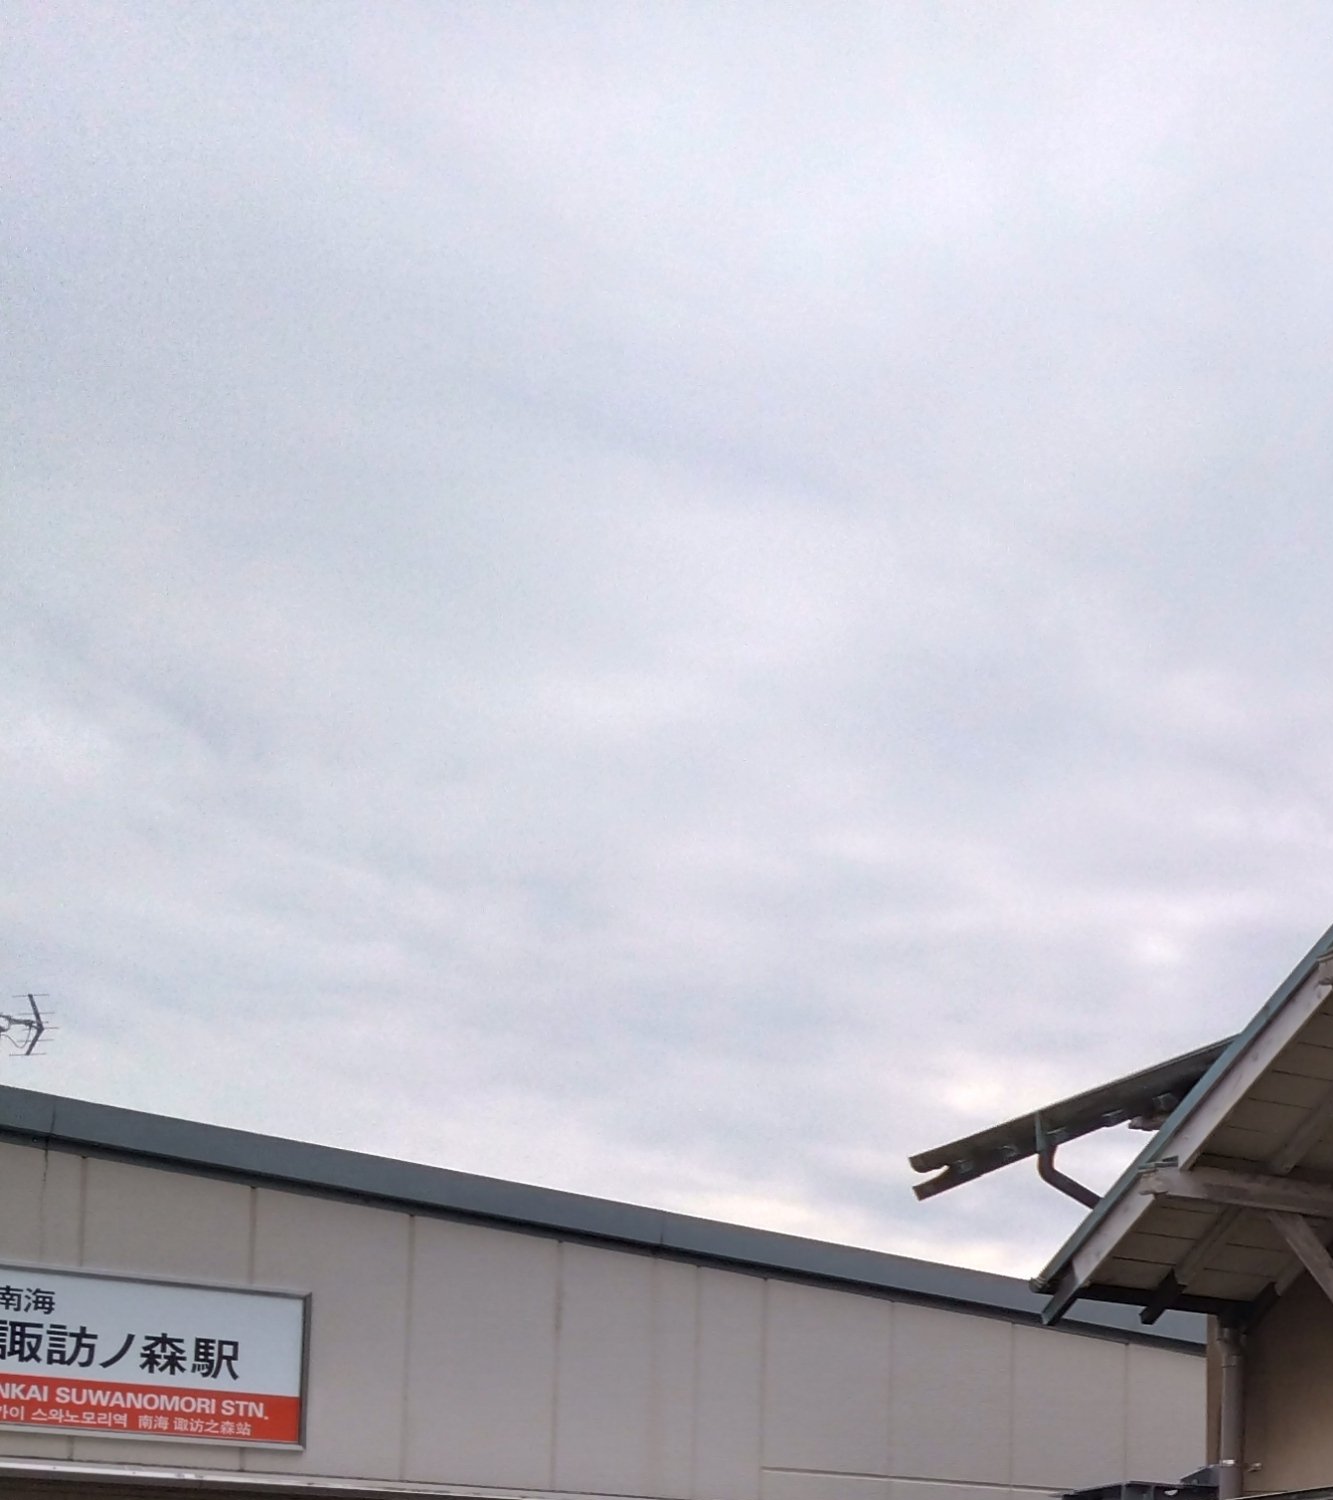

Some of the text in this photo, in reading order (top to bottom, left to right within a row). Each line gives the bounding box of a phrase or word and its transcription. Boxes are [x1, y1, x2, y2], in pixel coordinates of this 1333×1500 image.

[0, 1286, 55, 1315] 南海
[0, 1320, 240, 1380] 諏訪ノ森駅
[31, 1408, 128, 1428] 스와노모리역
[55, 1387, 216, 1414] SUWANOMORI
[221, 1400, 269, 1420] STN.
